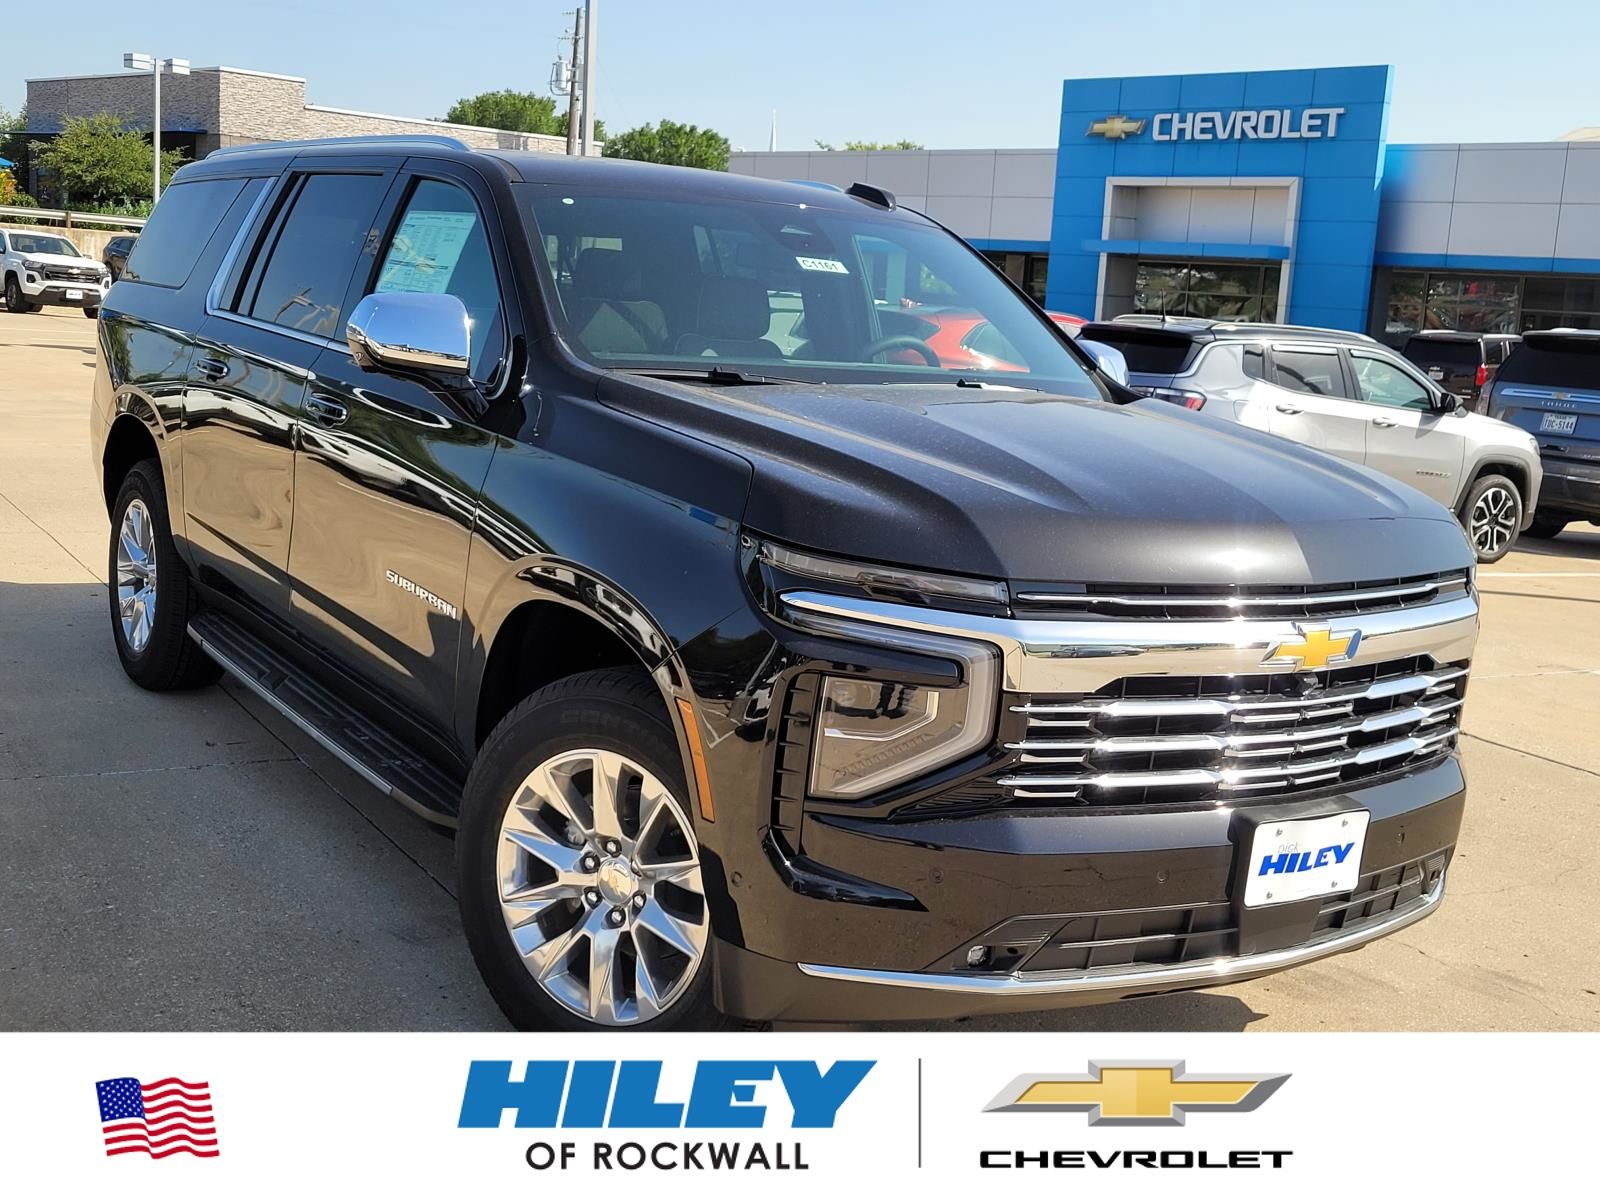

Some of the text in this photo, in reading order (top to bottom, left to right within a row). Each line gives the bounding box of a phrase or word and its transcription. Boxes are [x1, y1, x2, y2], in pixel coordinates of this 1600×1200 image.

[1152, 107, 1345, 141] CHEVROLET
[386, 568, 457, 619] SUBURBAN
[1258, 842, 1355, 876] HILEY
